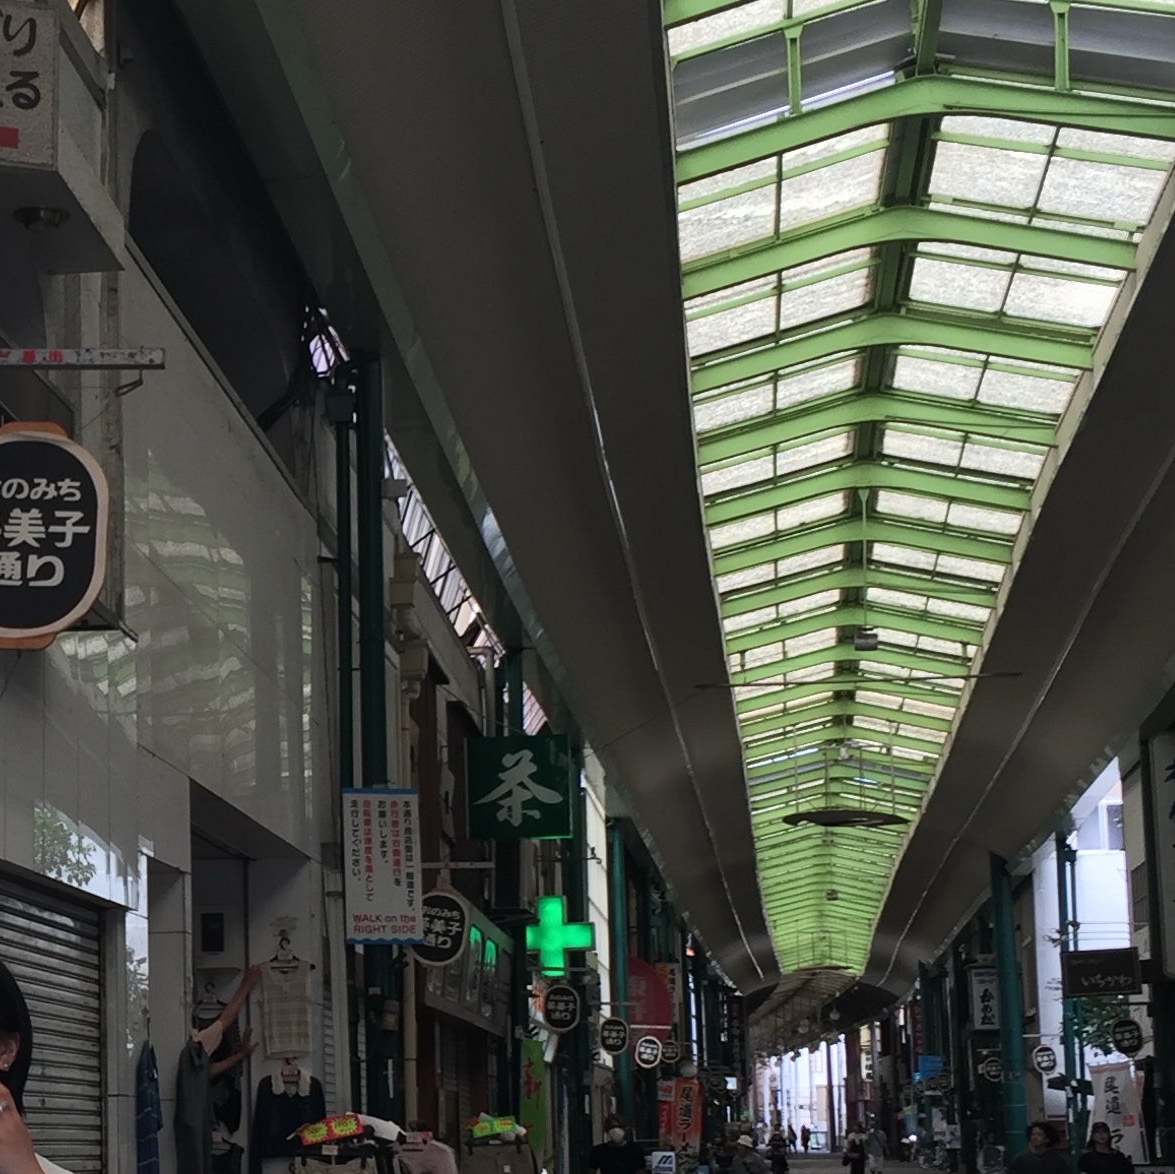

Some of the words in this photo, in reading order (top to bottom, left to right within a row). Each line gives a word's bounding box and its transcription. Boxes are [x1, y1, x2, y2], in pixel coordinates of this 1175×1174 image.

[472, 748, 563, 827] 茶
[352, 914, 382, 923] WALK
[384, 915, 398, 923] on
[400, 914, 417, 923] the
[353, 925, 387, 934] RIGHT
[390, 925, 416, 934] SIDE
